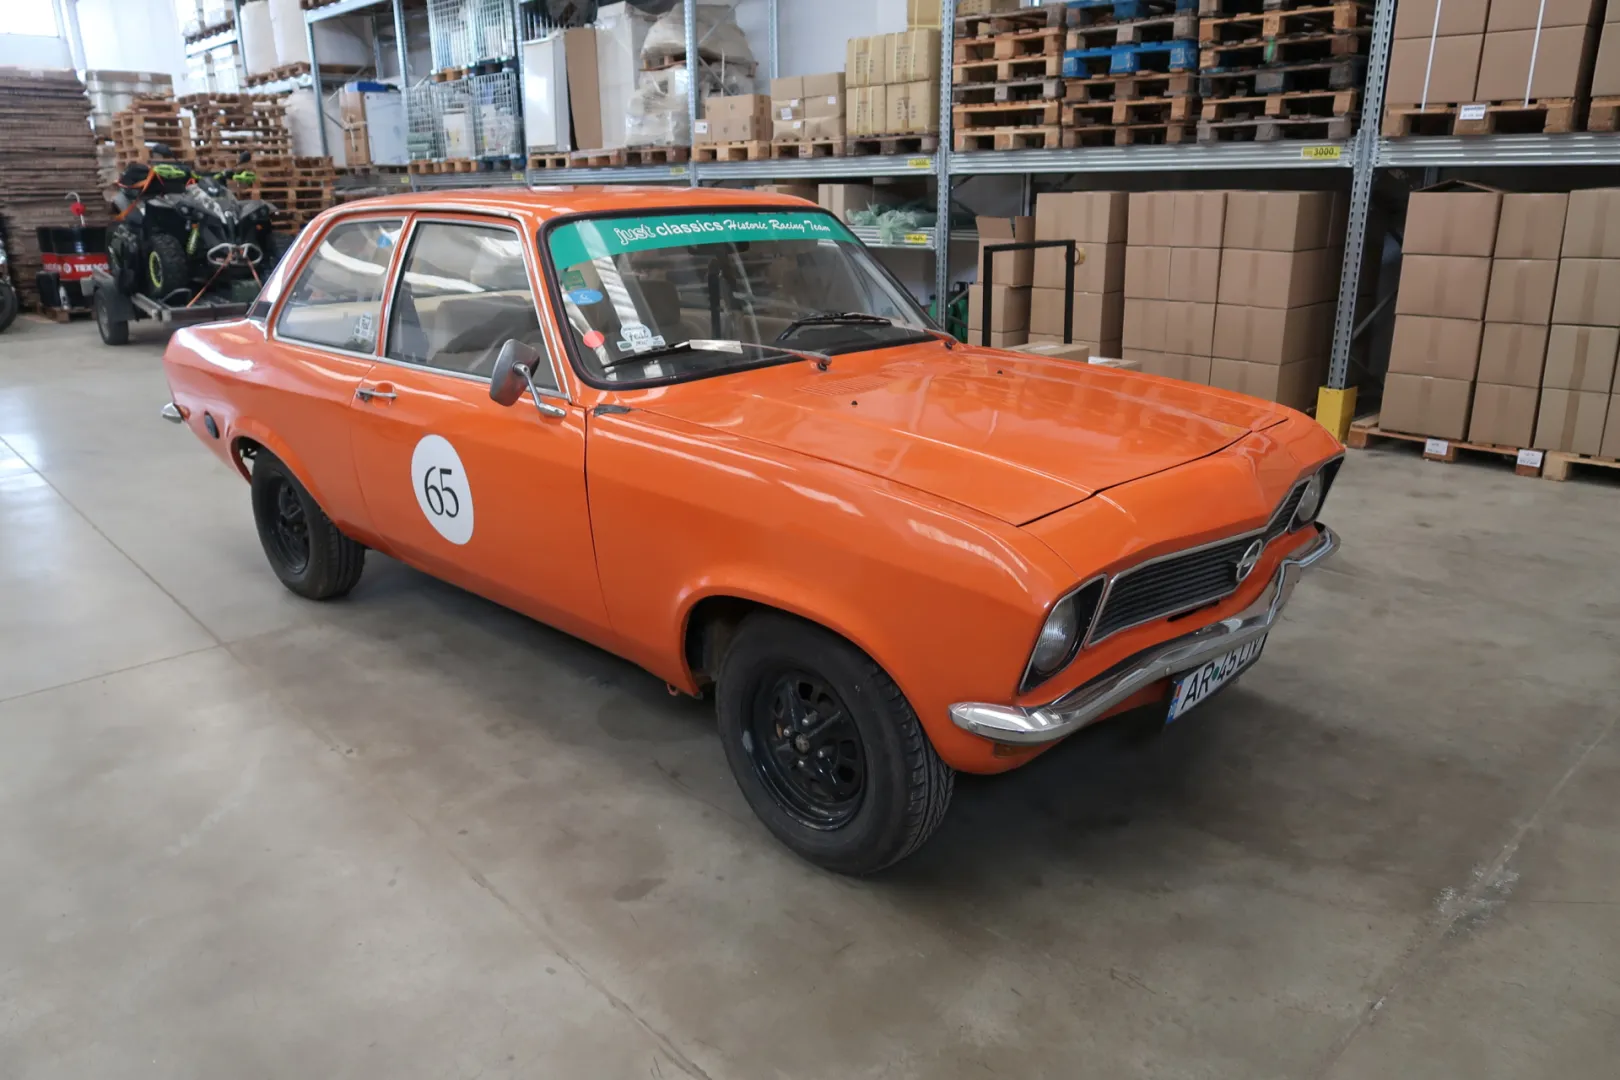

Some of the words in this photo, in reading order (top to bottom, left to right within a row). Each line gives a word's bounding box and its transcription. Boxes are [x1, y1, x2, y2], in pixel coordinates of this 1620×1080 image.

[1313, 147, 1334, 156] 3000
[613, 223, 656, 246] just
[656, 219, 723, 237] classics
[723, 219, 768, 231] Historic
[768, 219, 805, 233] Racing
[804, 219, 831, 232] Team
[424, 466, 459, 518] 65
[1181, 662, 1215, 710] AR
